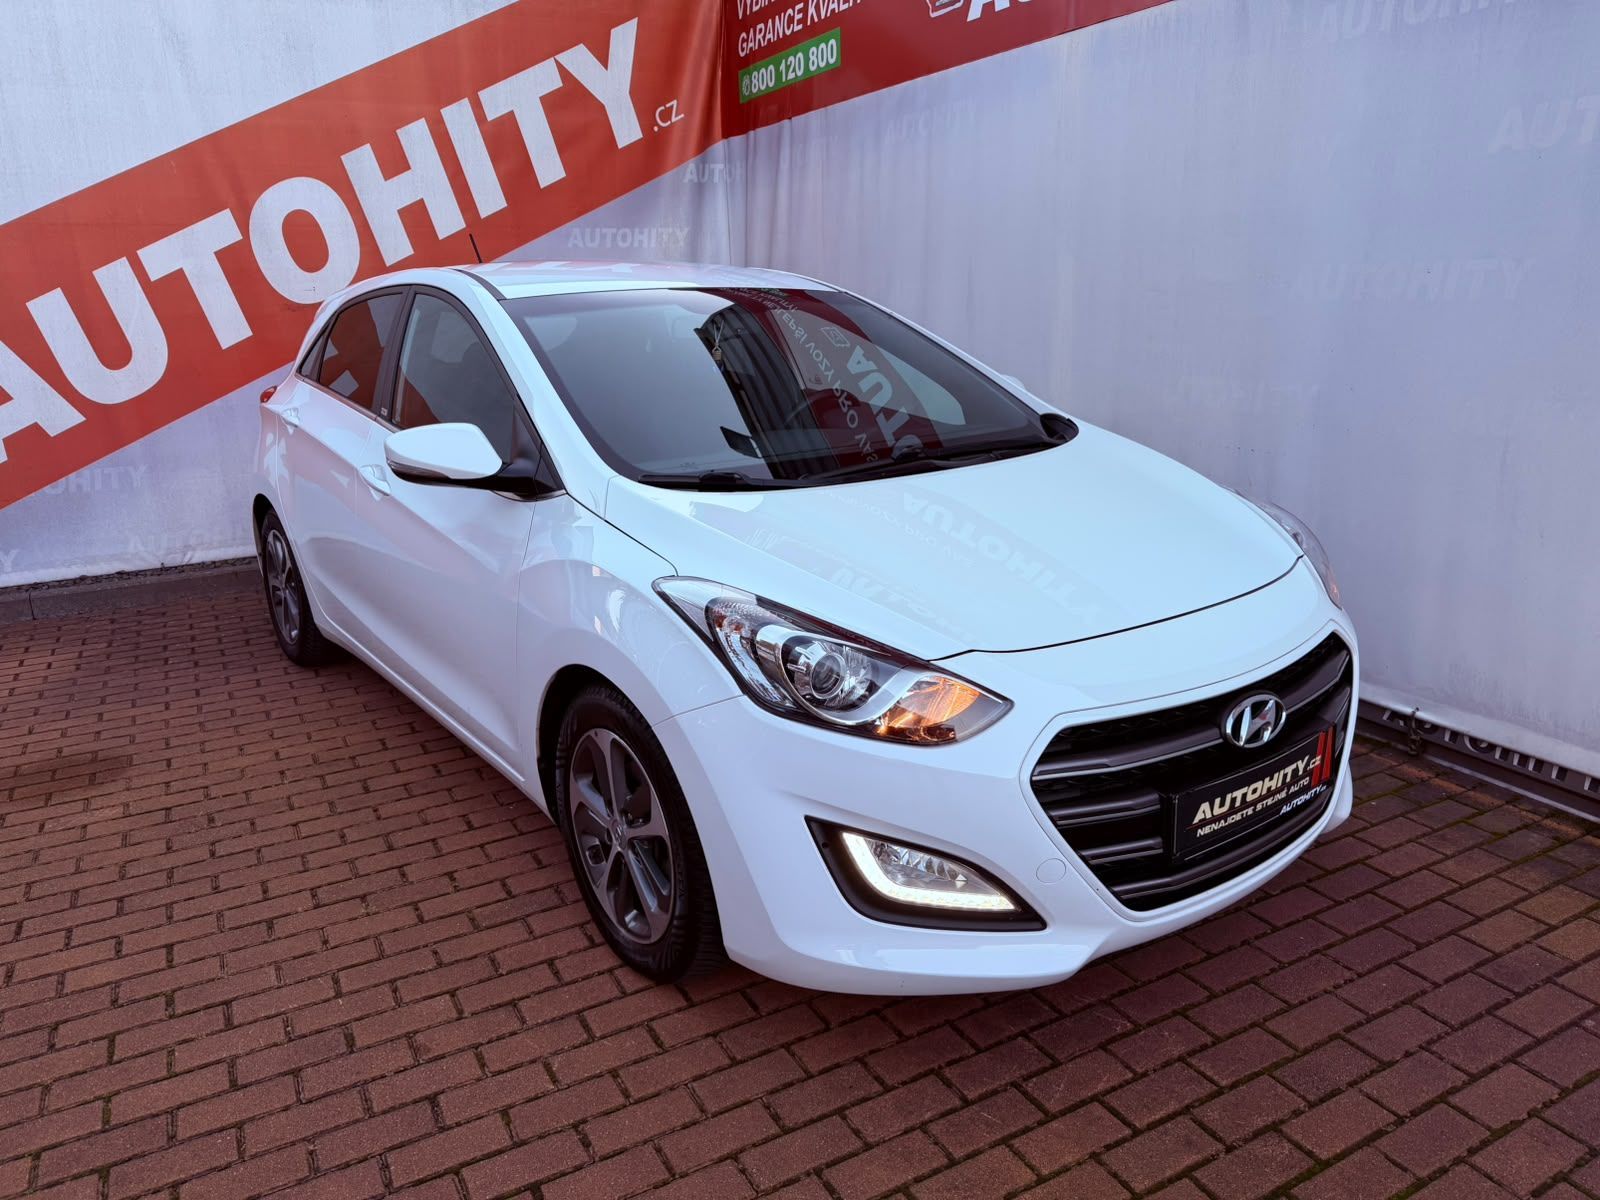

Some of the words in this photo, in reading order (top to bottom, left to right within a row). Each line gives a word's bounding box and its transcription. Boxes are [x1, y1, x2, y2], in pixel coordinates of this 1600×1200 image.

[738, 2, 805, 58] GARANCE
[750, 64, 776, 94] 800
[779, 54, 805, 82] 120
[808, 38, 838, 72] 800
[567, 227, 690, 249] AUTOHITY
[1196, 805, 1255, 838] NENAJDETE
[1288, 776, 1310, 795] AUTO
